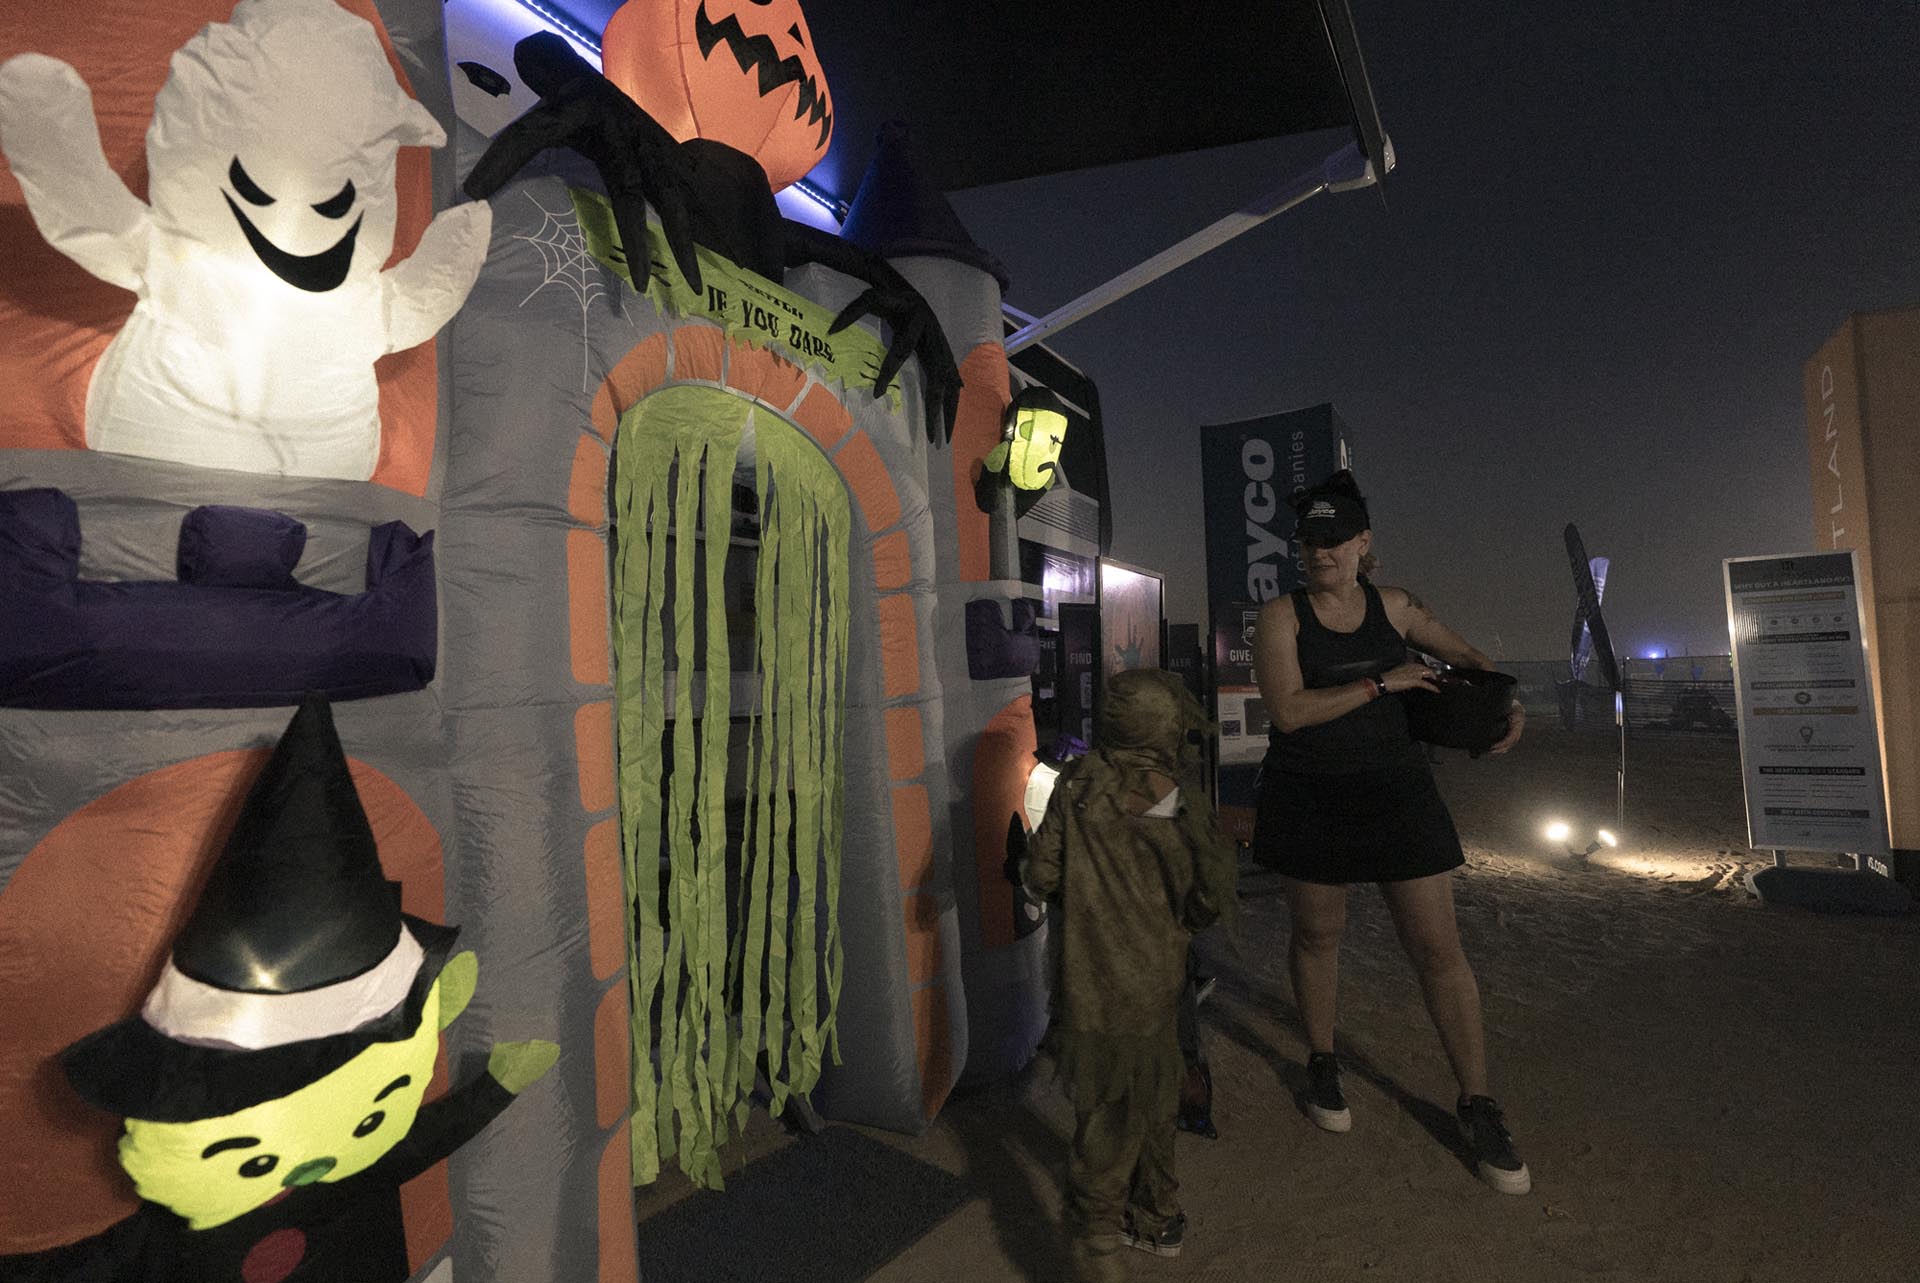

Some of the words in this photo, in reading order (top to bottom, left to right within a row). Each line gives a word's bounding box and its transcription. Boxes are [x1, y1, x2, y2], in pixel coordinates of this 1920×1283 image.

[707, 284, 728, 318] IF
[741, 299, 779, 338] YOU
[788, 323, 836, 364] DARE
[1821, 365, 1845, 550] TLAND
[1241, 437, 1289, 603] ayco
[1069, 652, 1093, 665] FIND
[1229, 649, 1253, 662] GIVE
